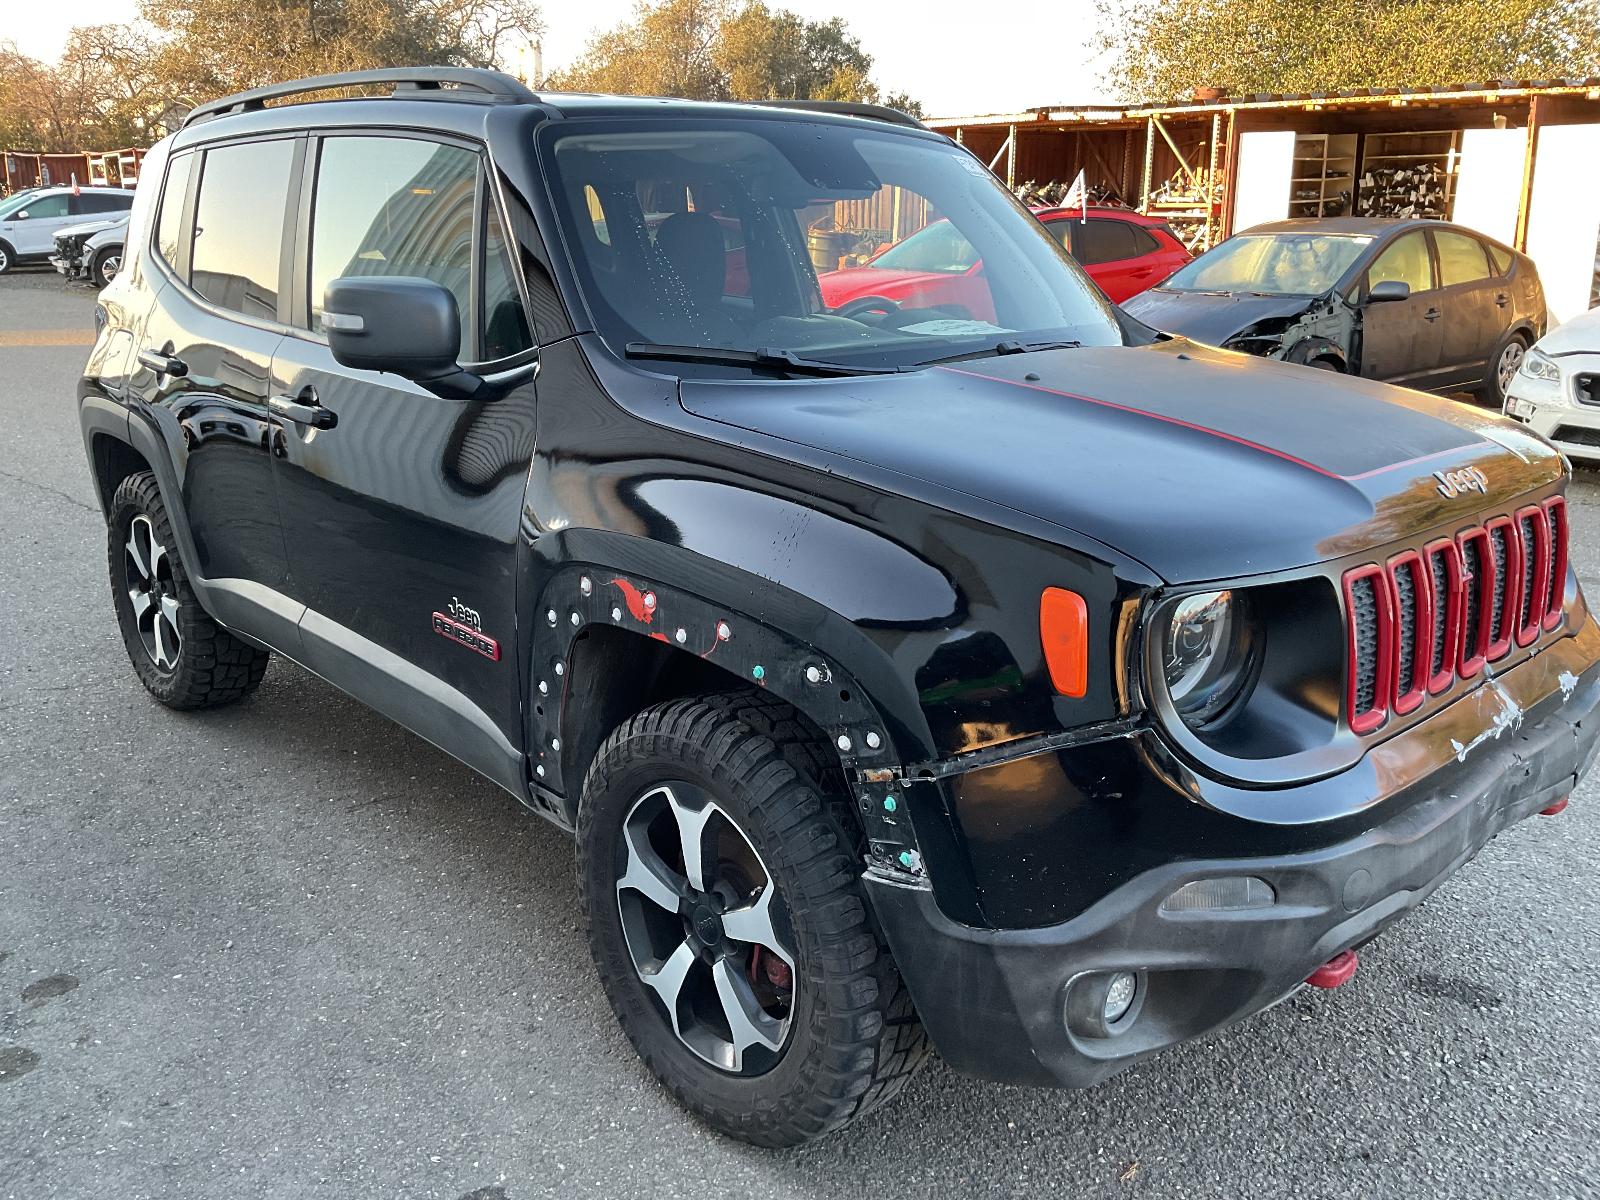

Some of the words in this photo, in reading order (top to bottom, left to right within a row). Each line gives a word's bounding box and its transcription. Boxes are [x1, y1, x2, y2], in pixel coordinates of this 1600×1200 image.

[1432, 465, 1489, 499] Jeep
[447, 596, 482, 633] Jeep
[434, 615, 495, 658] RENEGADE
